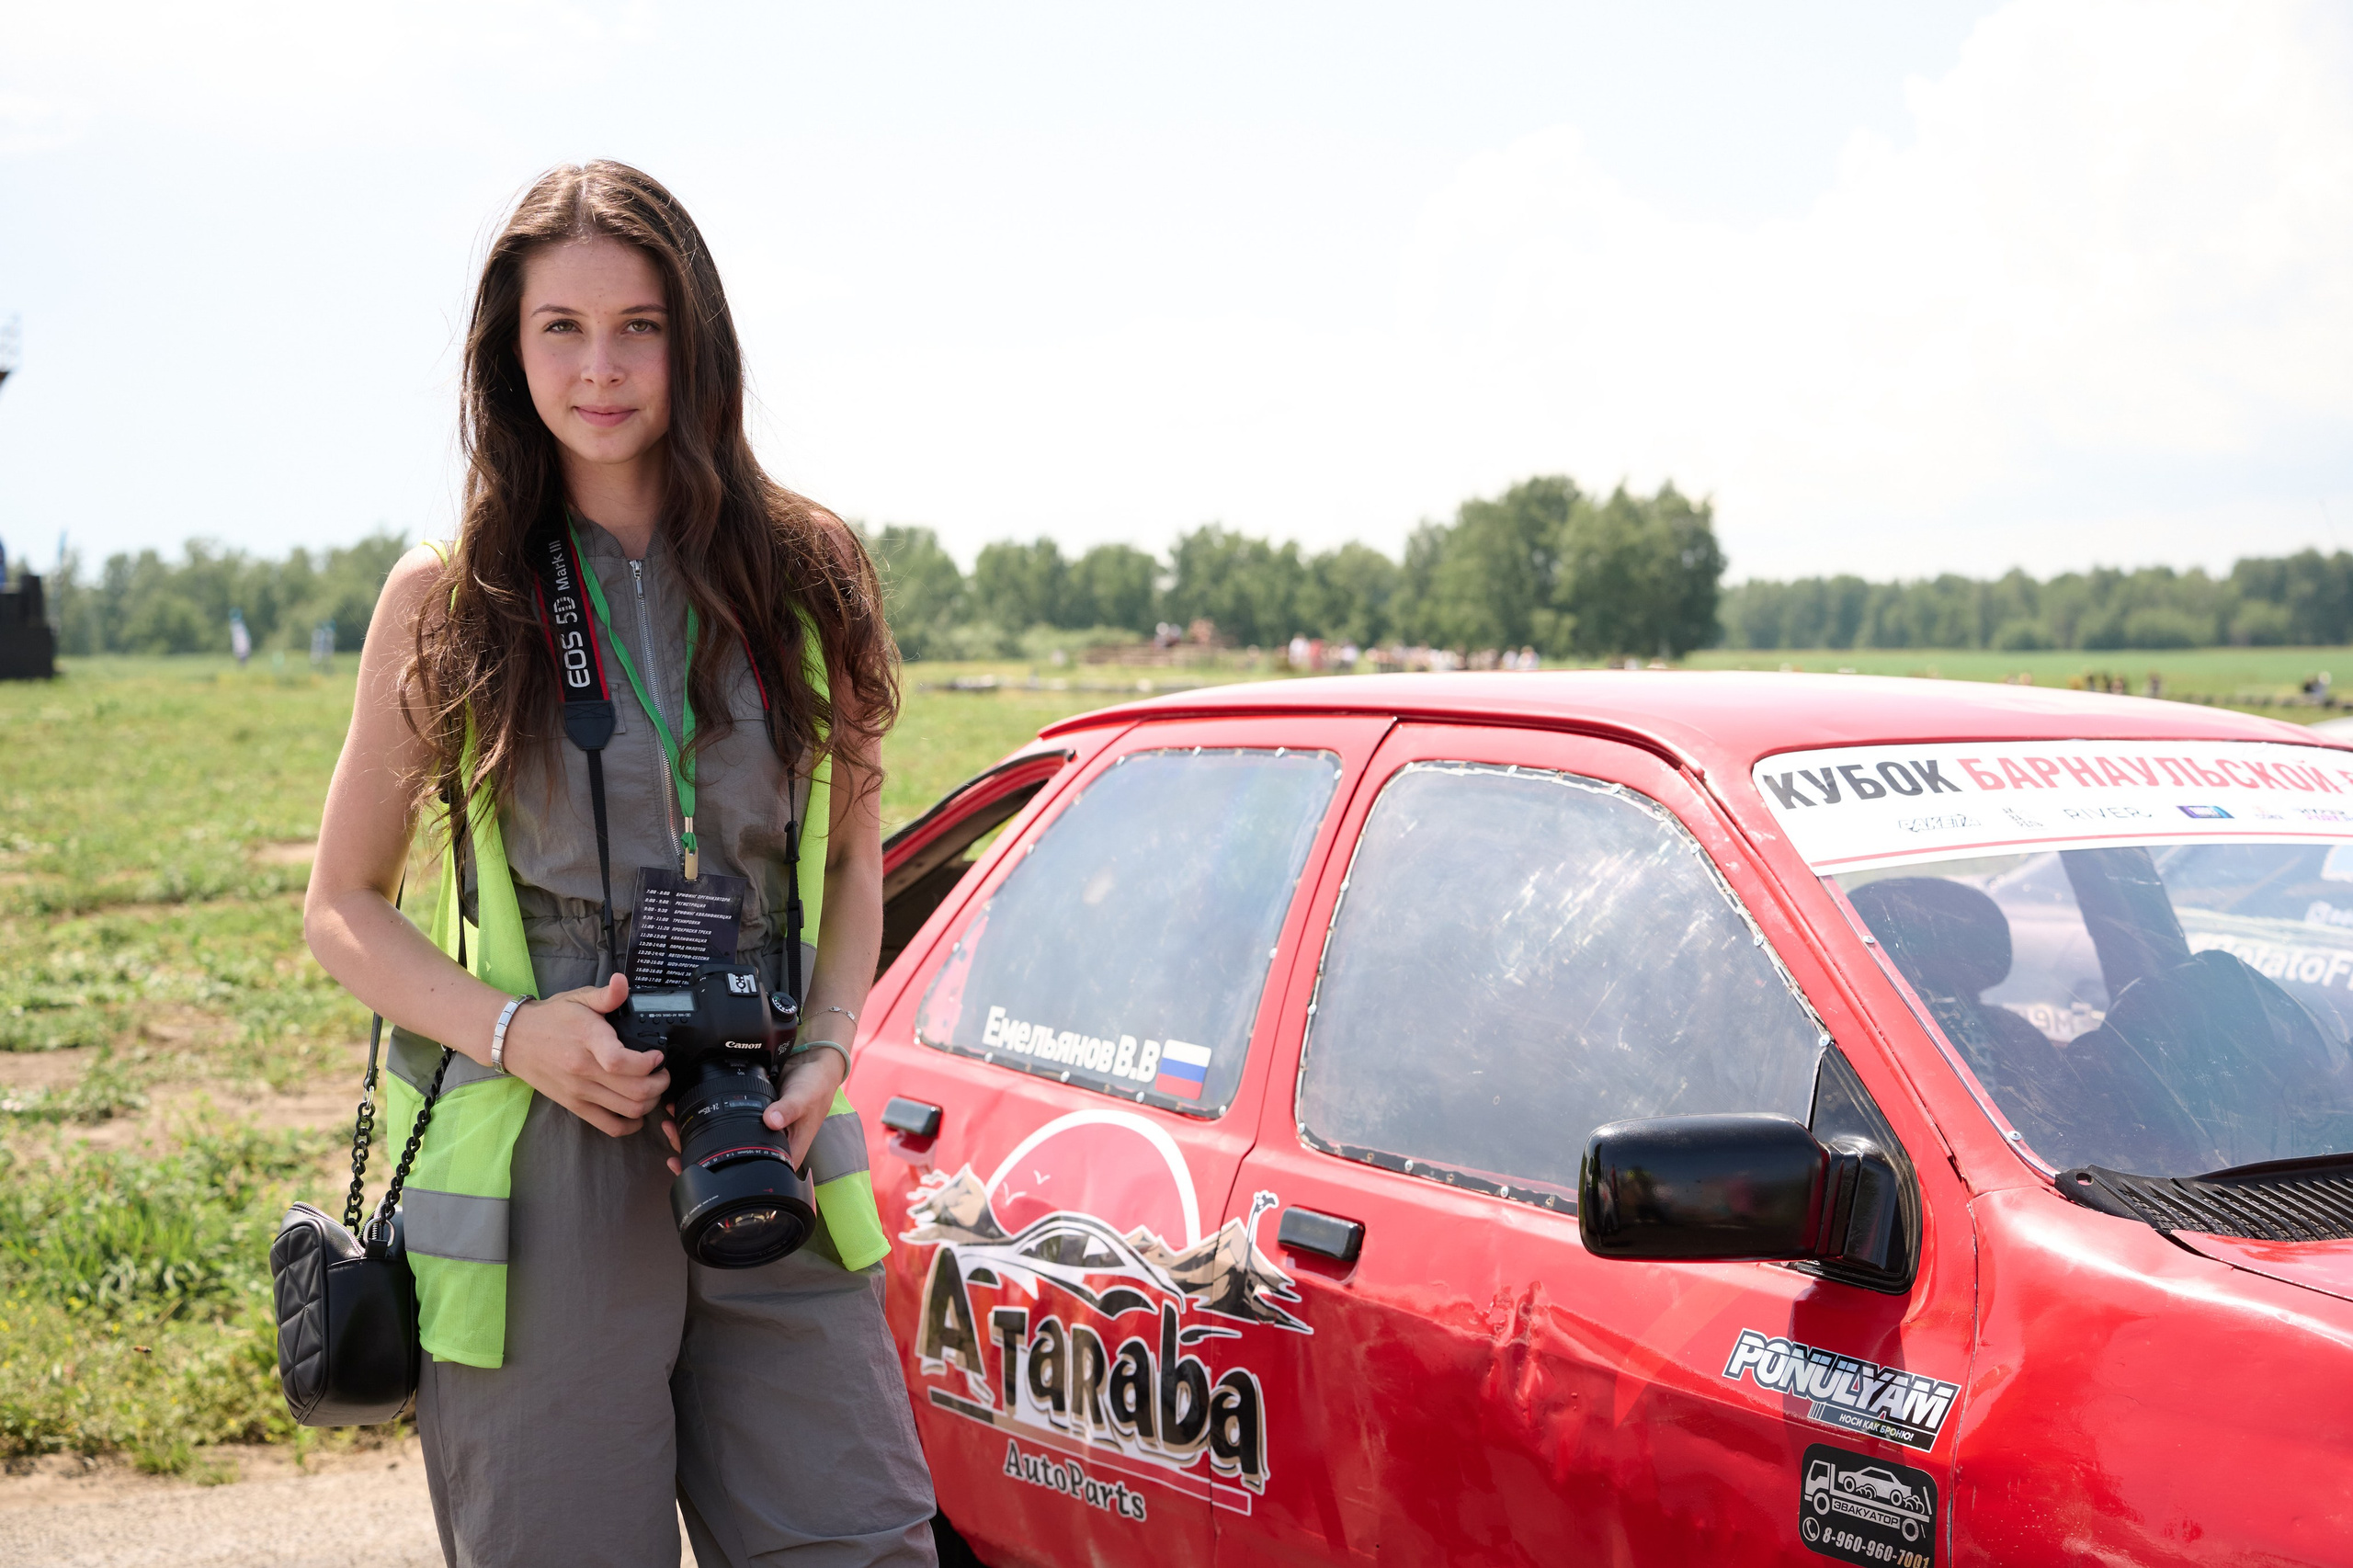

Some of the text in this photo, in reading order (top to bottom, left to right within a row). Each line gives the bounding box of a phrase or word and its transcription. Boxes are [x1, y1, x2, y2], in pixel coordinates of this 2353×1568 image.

[549, 540, 591, 688] EOS 5D Mark III
[1762, 756, 2345, 810] КУБОК БАРНАУЛЬСКОЙ
[725, 1040, 763, 1050] Canon
[982, 1006, 1117, 1074] Емельянов
[1726, 1332, 1953, 1431] PONULYAM
[1838, 1413, 1915, 1442] НОСИ КАК БРОНЮ!
[1003, 1438, 1148, 1523] AutoParts
[1833, 1499, 1899, 1527] ЭВАКУАТОР
[1822, 1526, 1930, 1568] 8-960-960-7001
